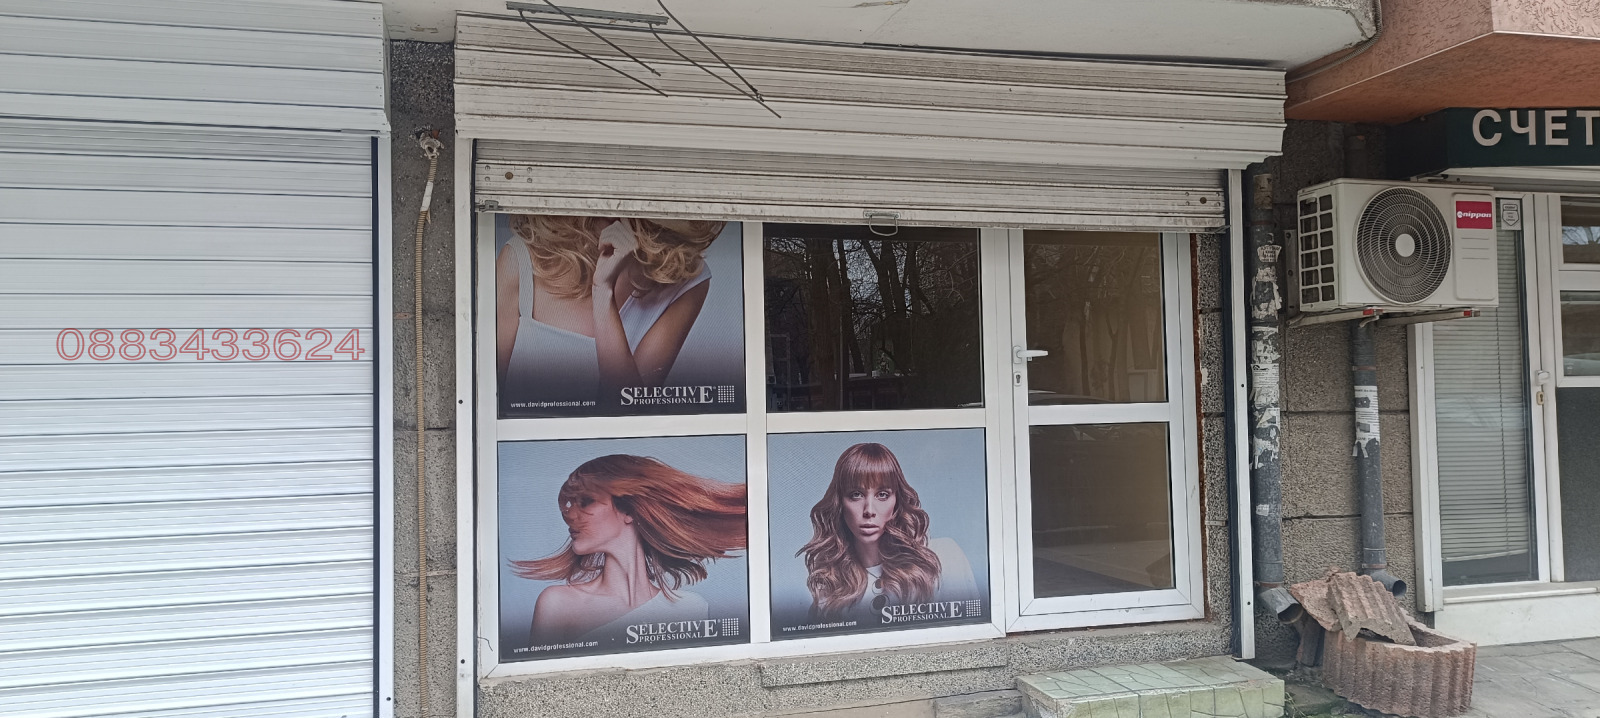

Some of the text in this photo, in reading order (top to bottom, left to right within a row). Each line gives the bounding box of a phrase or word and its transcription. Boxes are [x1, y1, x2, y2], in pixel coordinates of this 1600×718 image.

[1472, 109, 1600, 146] СЧЕТ
[1462, 211, 1492, 219] nippon
[56, 327, 365, 361] 0883433624
[620, 385, 714, 406] SELECTIVE
[633, 397, 699, 405] PROFESSIONAL
[510, 400, 596, 409] www.davidprofessional.com
[881, 600, 963, 624] SELECTIVE
[893, 613, 949, 623] PROFESSIONAL
[626, 619, 718, 644] SELECTIVE
[639, 632, 702, 643] PROFESSIONAL
[513, 640, 599, 653] www.davidprofessional.com
